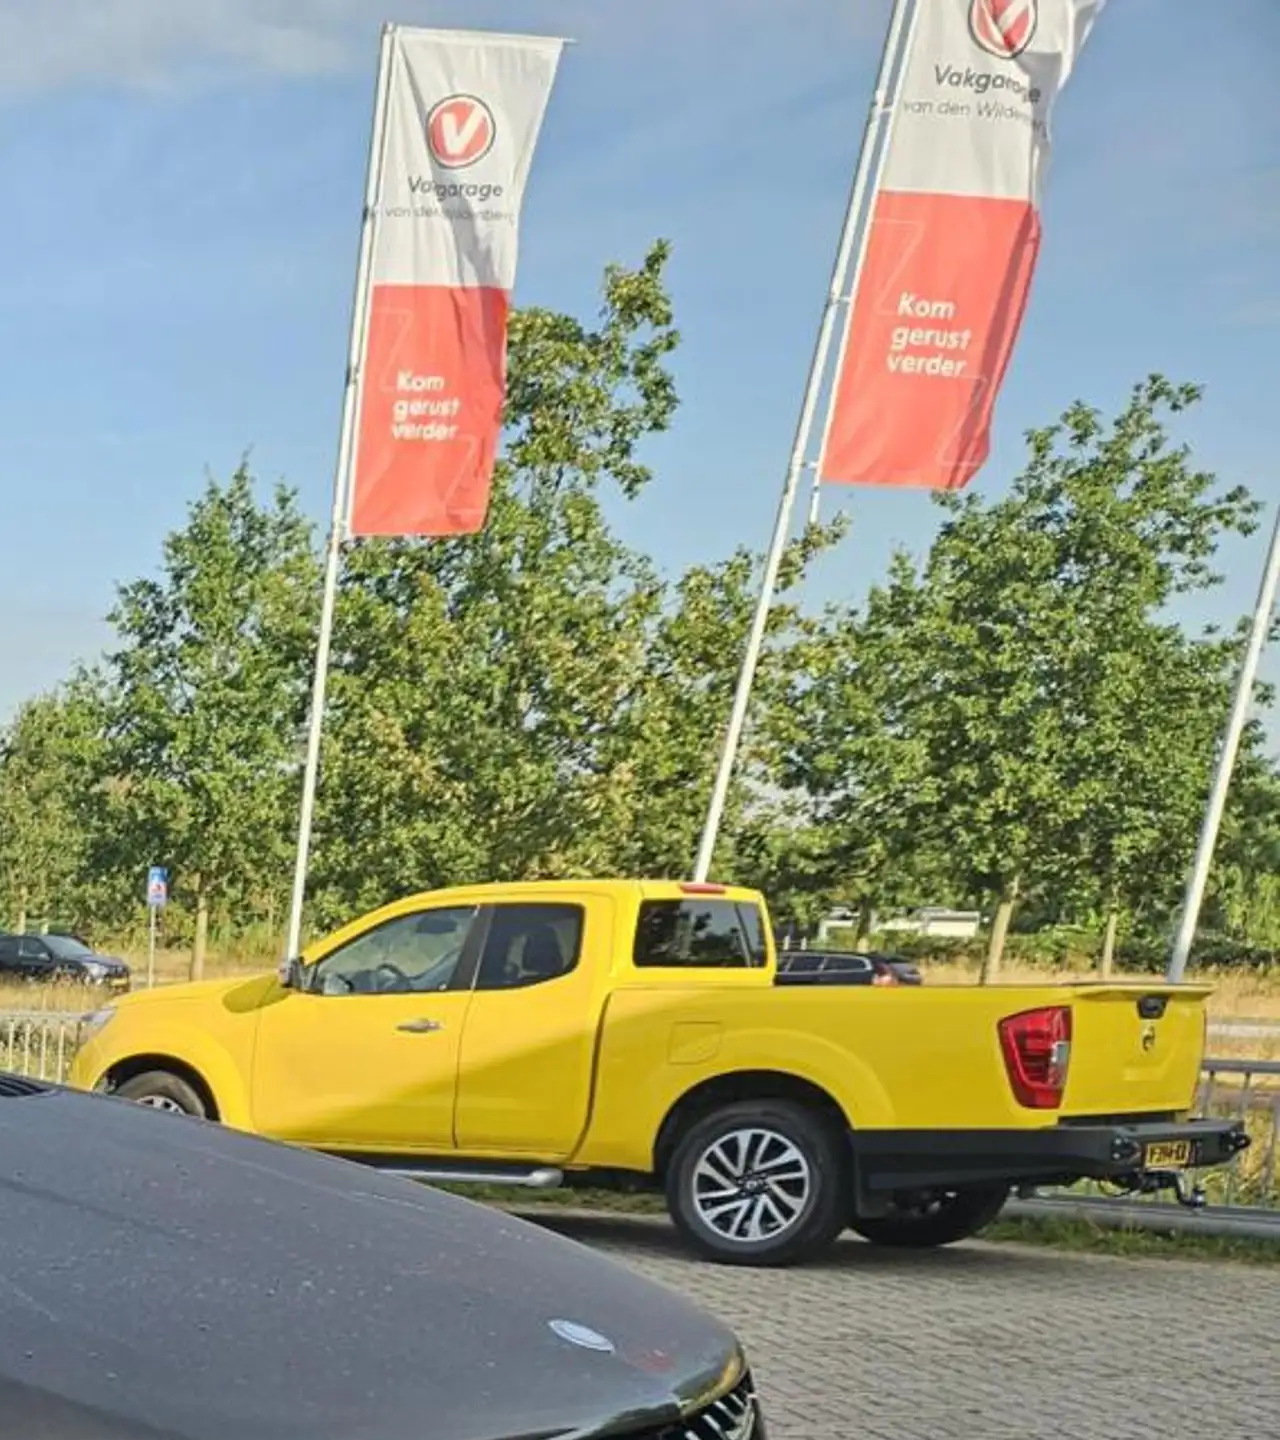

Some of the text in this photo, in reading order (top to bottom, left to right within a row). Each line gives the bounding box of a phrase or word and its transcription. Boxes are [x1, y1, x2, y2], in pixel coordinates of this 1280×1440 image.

[407, 176, 503, 202] Vagarage
[898, 291, 955, 319] Kom
[891, 327, 971, 351] gerust
[886, 353, 967, 378] verder
[397, 369, 445, 391] Kom
[392, 397, 460, 423] gerust
[391, 422, 458, 441] verder
